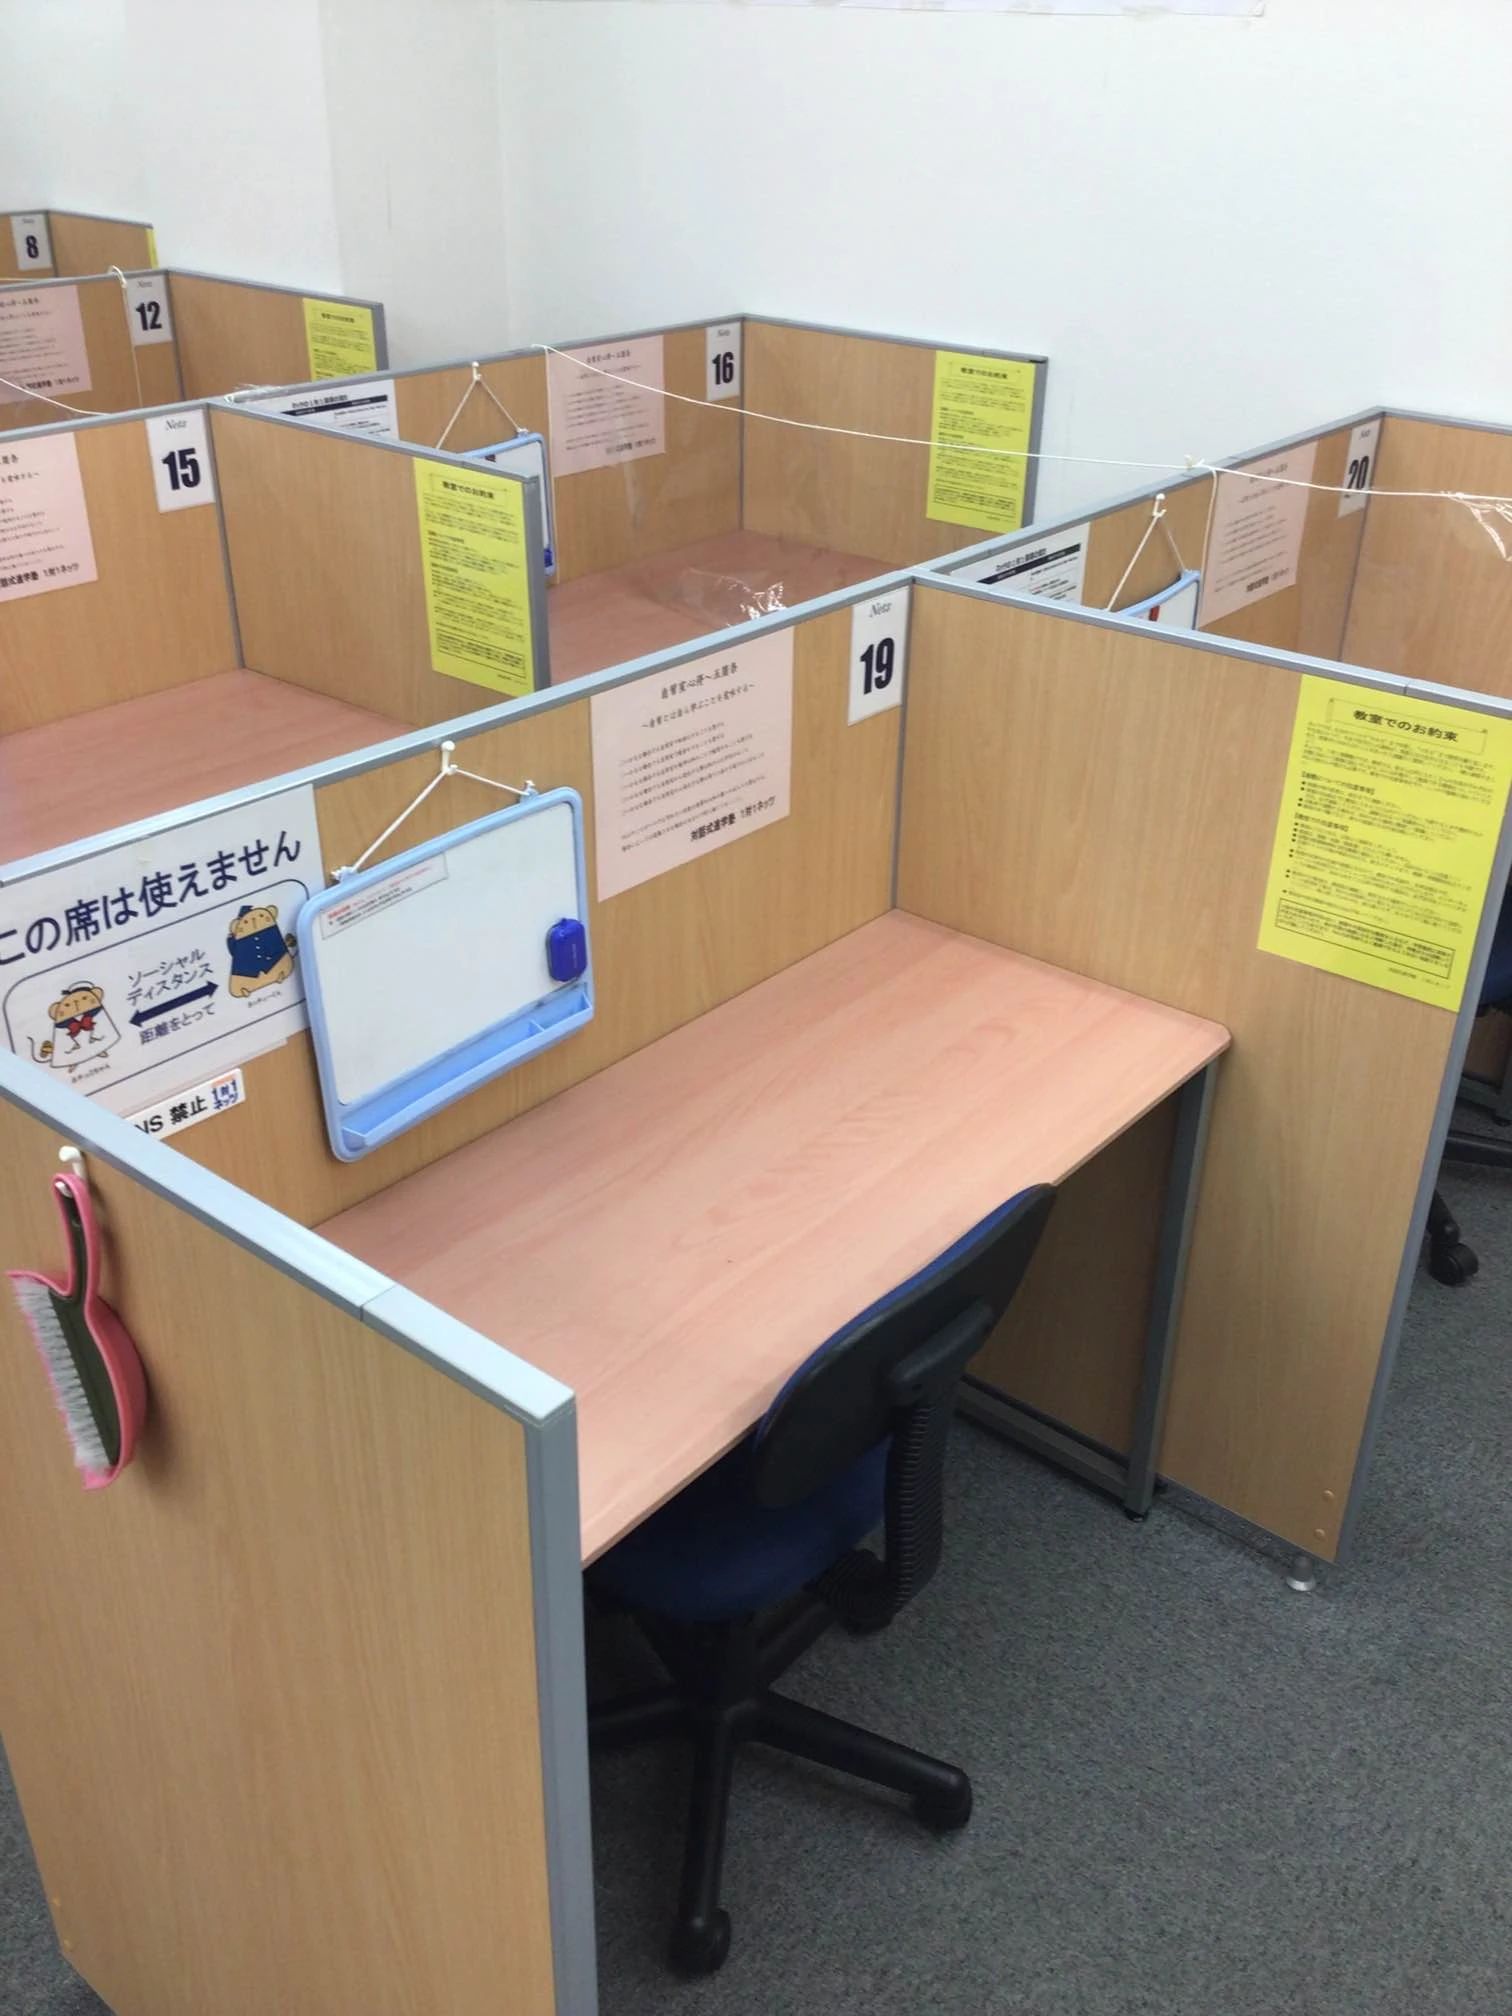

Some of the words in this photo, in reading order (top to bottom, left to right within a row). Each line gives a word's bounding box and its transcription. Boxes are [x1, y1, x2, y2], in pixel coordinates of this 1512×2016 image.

[26, 235, 39, 259] 8
[136, 301, 162, 331] 12
[712, 351, 734, 385] 16
[161, 447, 201, 491] 15
[1344, 455, 1369, 498] 20
[860, 637, 895, 695] 19
[1353, 709, 1459, 743] 教室でのお約束
[0, 829, 301, 965] この席は使えません
[126, 962, 214, 1006] ディスタンス
[128, 948, 206, 988] ソーシャル
[139, 1002, 217, 1045] 距離をとって
[169, 1095, 208, 1125] 禁止
